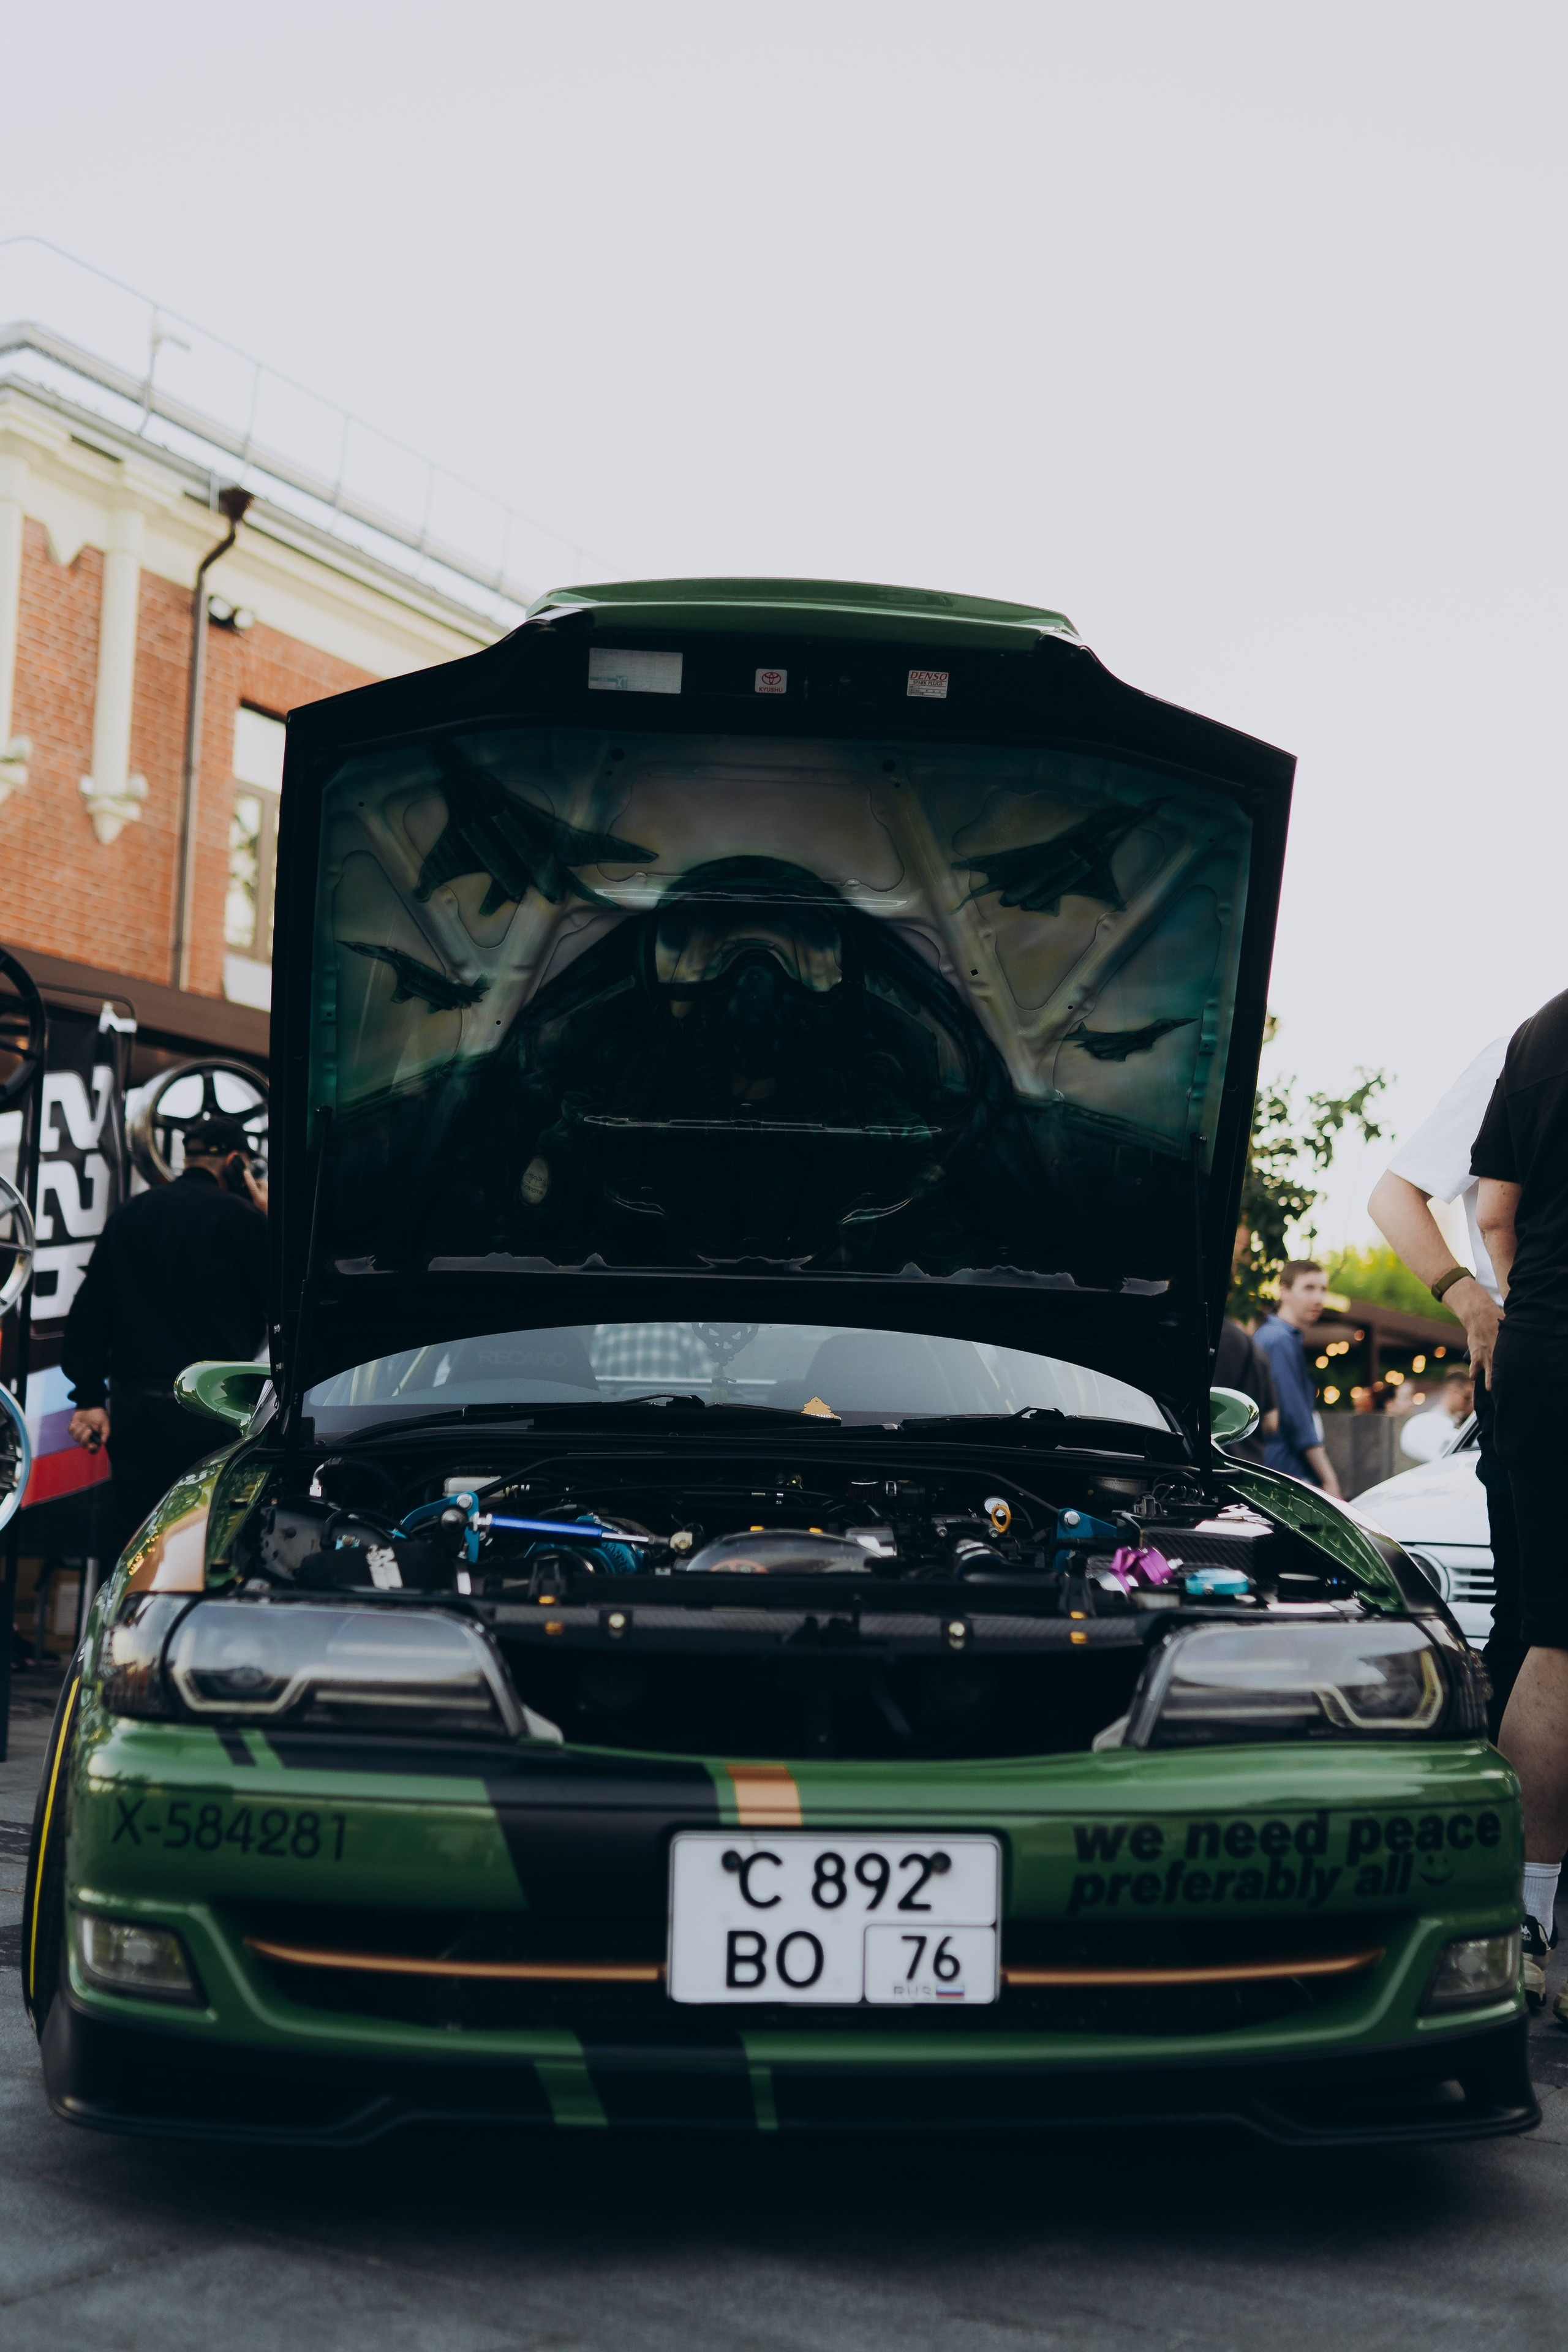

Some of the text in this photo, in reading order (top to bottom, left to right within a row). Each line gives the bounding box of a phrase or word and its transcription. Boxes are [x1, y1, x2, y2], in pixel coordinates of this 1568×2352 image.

[910, 671, 948, 680] DENSO
[478, 1349, 568, 1368] RECARO
[111, 1796, 347, 1862] X-584281
[1072, 1810, 1502, 1867] we need peace
[739, 1851, 932, 1911] C 892
[1065, 1854, 1415, 1915] preferably all
[725, 1929, 824, 1989] BO
[900, 1935, 962, 1982] 76
[892, 1985, 933, 2000] RUS
